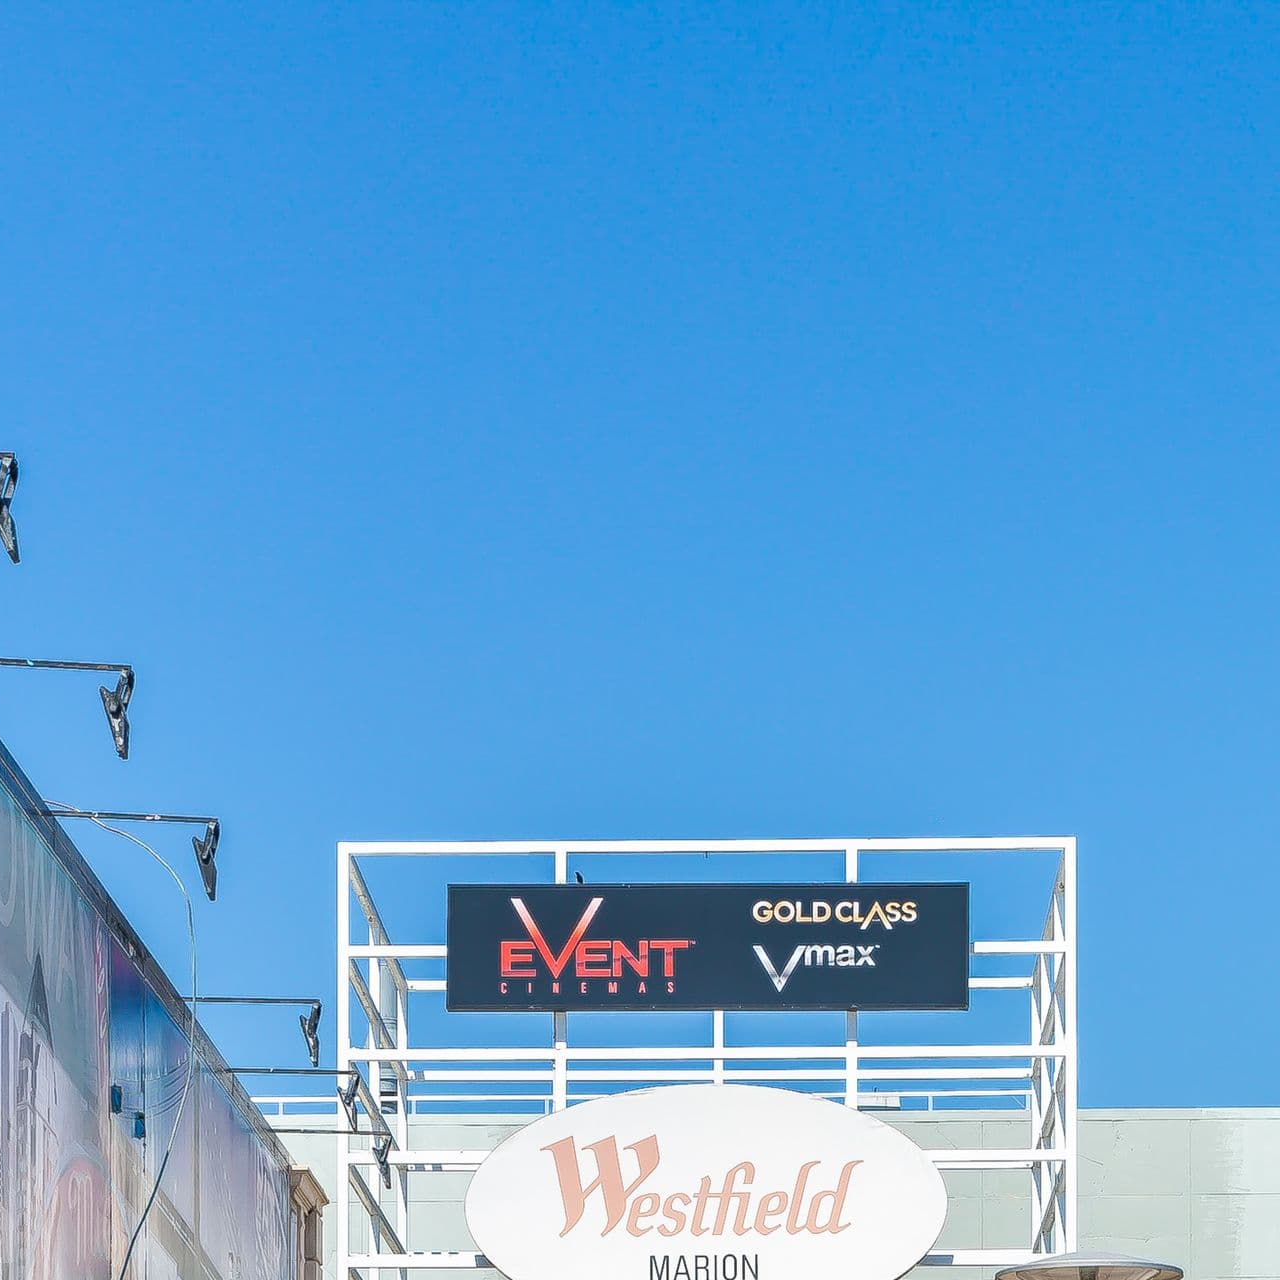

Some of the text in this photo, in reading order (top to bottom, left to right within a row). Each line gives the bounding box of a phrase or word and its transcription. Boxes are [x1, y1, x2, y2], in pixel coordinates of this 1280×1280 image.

[500, 897, 689, 980] EVENT
[752, 900, 918, 931] GOLD CLASS
[500, 981, 676, 995] CINEMAS
[539, 1134, 865, 1239] Westfield
